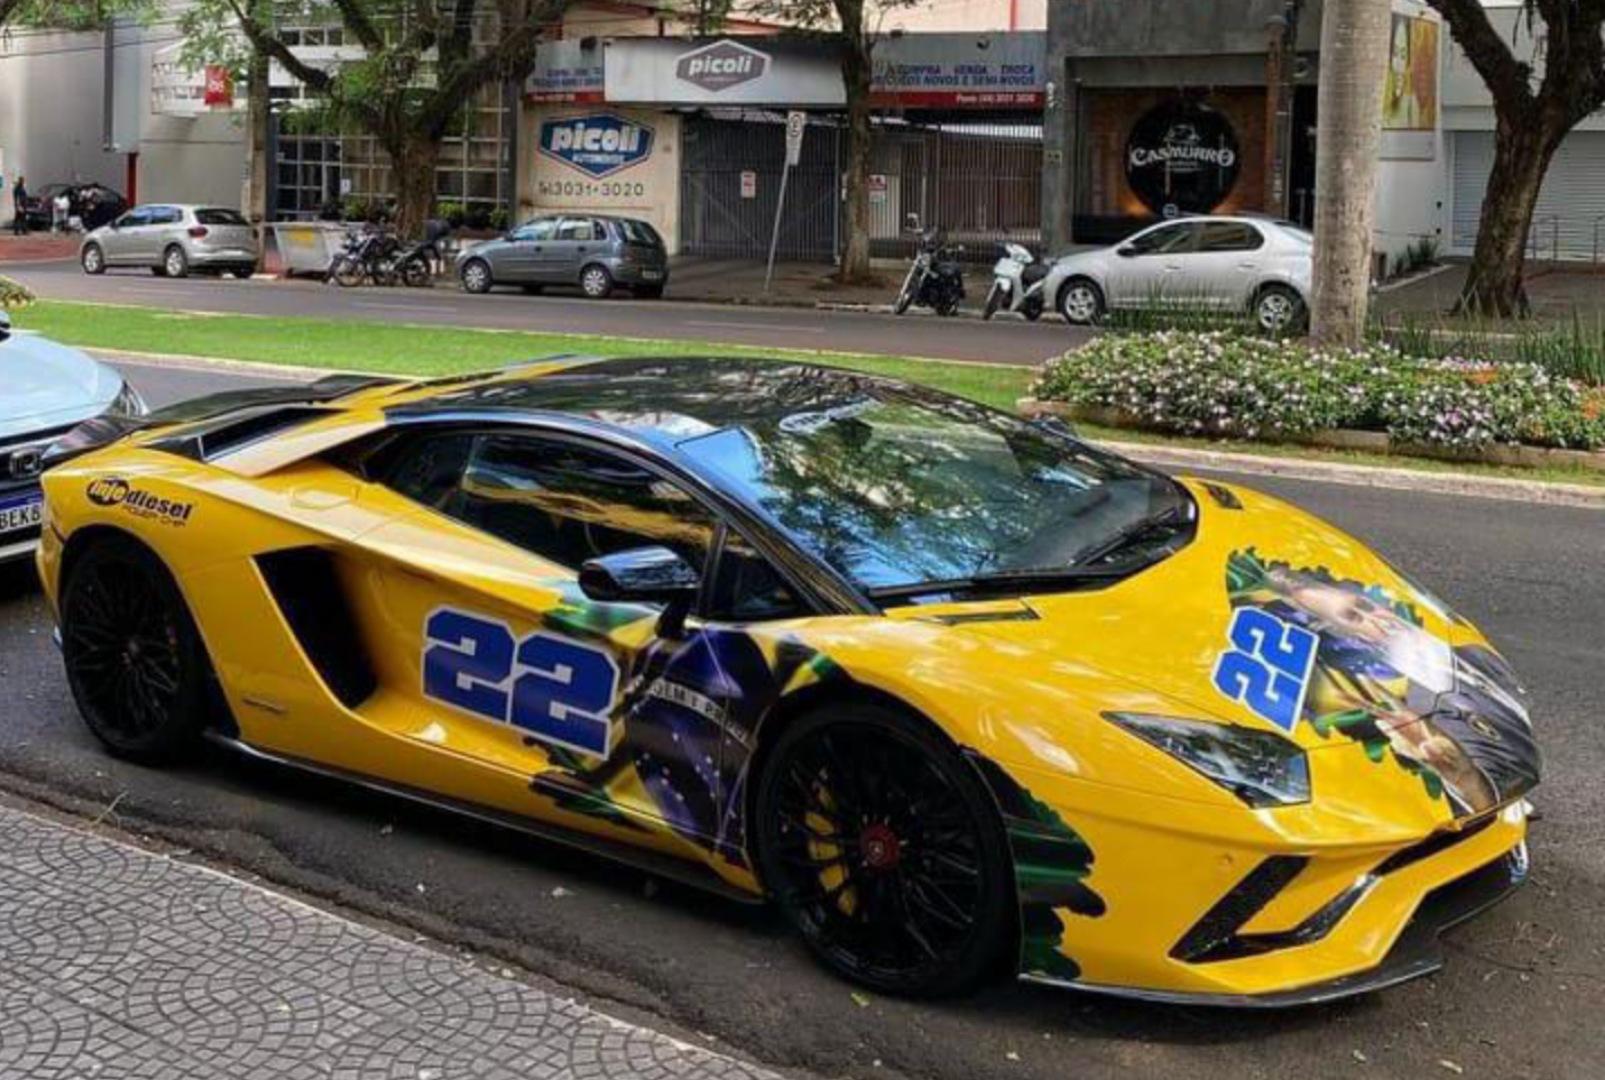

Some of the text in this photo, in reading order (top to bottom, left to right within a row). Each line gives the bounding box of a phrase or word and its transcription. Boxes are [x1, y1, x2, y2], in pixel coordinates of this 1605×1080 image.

[688, 53, 753, 76] picoli
[550, 122, 640, 151] picoli
[1130, 146, 1236, 168] CASMURRO
[422, 606, 620, 761] 22
[1211, 605, 1320, 733] 22
